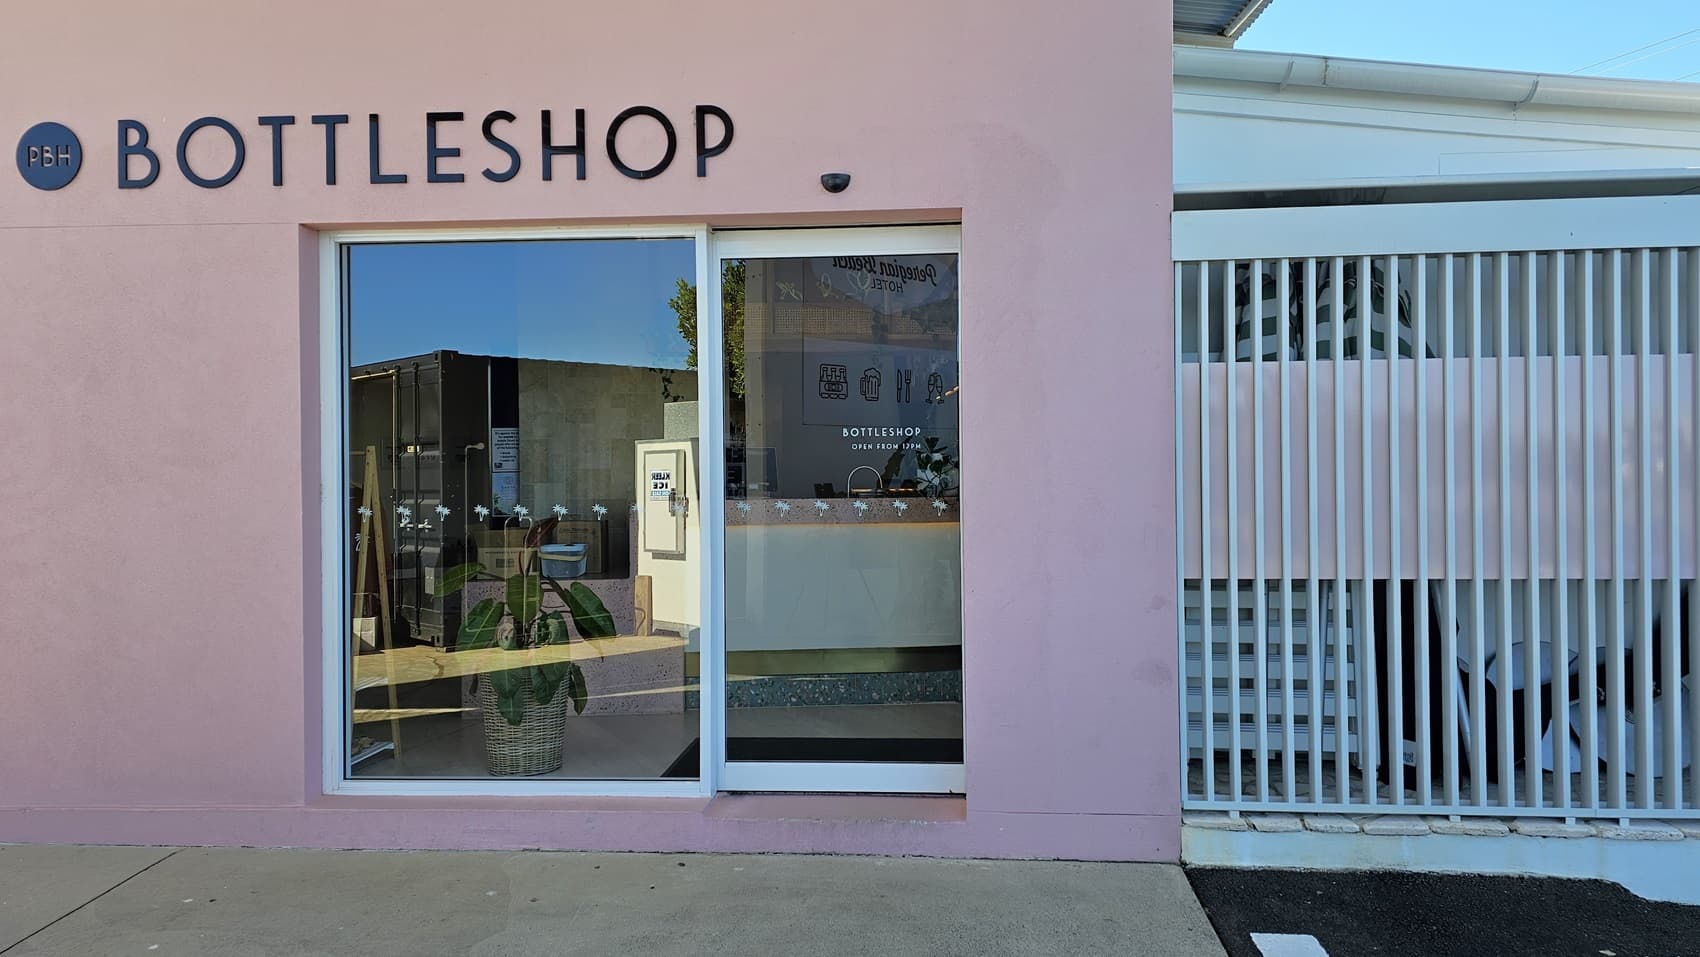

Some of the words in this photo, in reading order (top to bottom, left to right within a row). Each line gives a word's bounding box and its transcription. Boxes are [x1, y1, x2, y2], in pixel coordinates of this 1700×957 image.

[27, 145, 71, 168] PBH
[117, 104, 735, 189] BOTTLESHOP
[842, 427, 921, 437] BOTTLESHOP
